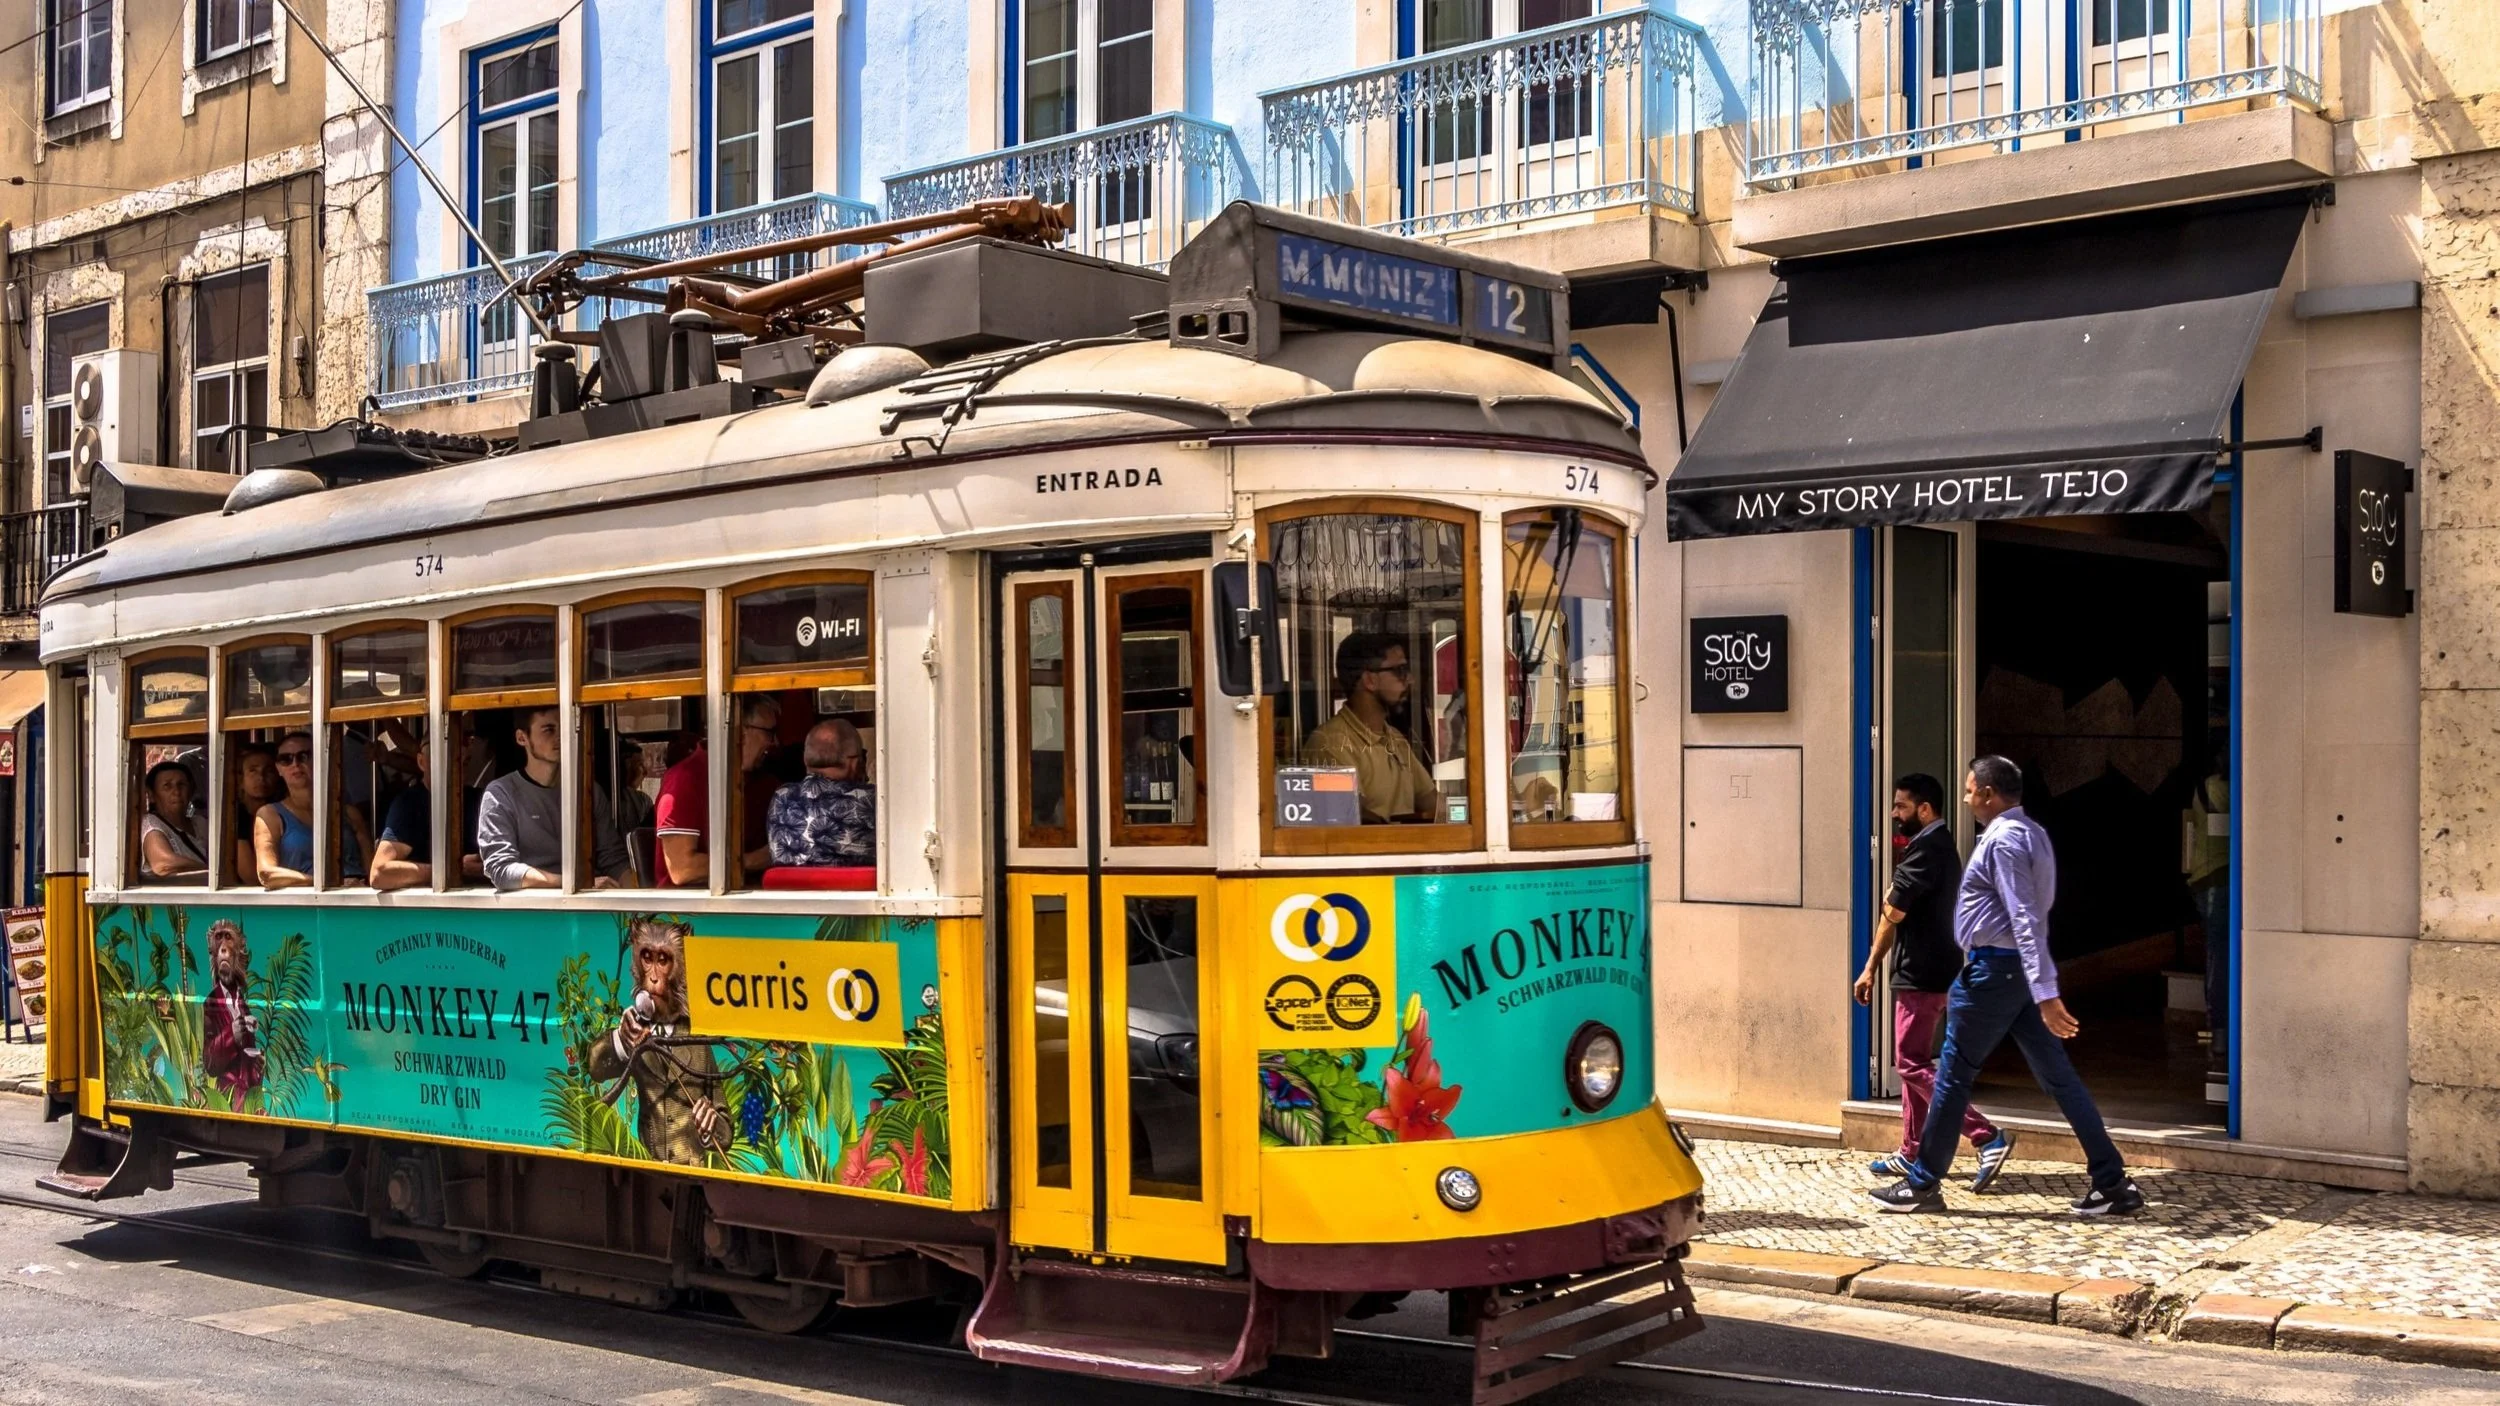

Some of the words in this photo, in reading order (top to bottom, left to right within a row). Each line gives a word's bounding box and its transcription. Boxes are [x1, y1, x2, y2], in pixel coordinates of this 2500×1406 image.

[1323, 253, 1434, 306] MONIZ
[1487, 279, 1526, 334] 12
[1035, 467, 1163, 494] ENTRADA
[1565, 465, 1599, 494] 574
[1735, 491, 1785, 520] MY
[1798, 483, 1901, 515] STORY
[1913, 476, 2023, 507] HOTEL
[2040, 469, 2128, 498] TEJO
[415, 554, 443, 577] 574
[820, 618, 860, 639] WI-FI
[1704, 666, 1754, 681] HOTEL
[157, 685, 179, 700] WI-FI
[1284, 779, 1311, 792] 12E
[1284, 803, 1313, 822] 02
[376, 932, 431, 965] CERTAINLY
[435, 932, 506, 969] WUNDERBAR
[1430, 907, 1636, 1010] MONKEY
[706, 960, 808, 1011] carris
[1497, 966, 1607, 1014] SCHWARZWALD
[343, 982, 498, 1040] MONKEY
[510, 989, 550, 1045] 47
[394, 1051, 506, 1080] SCHWARZWALD
[420, 1083, 449, 1105] DRY
[454, 1086, 481, 1110] GIN
[480, 1125, 499, 1133] COM
